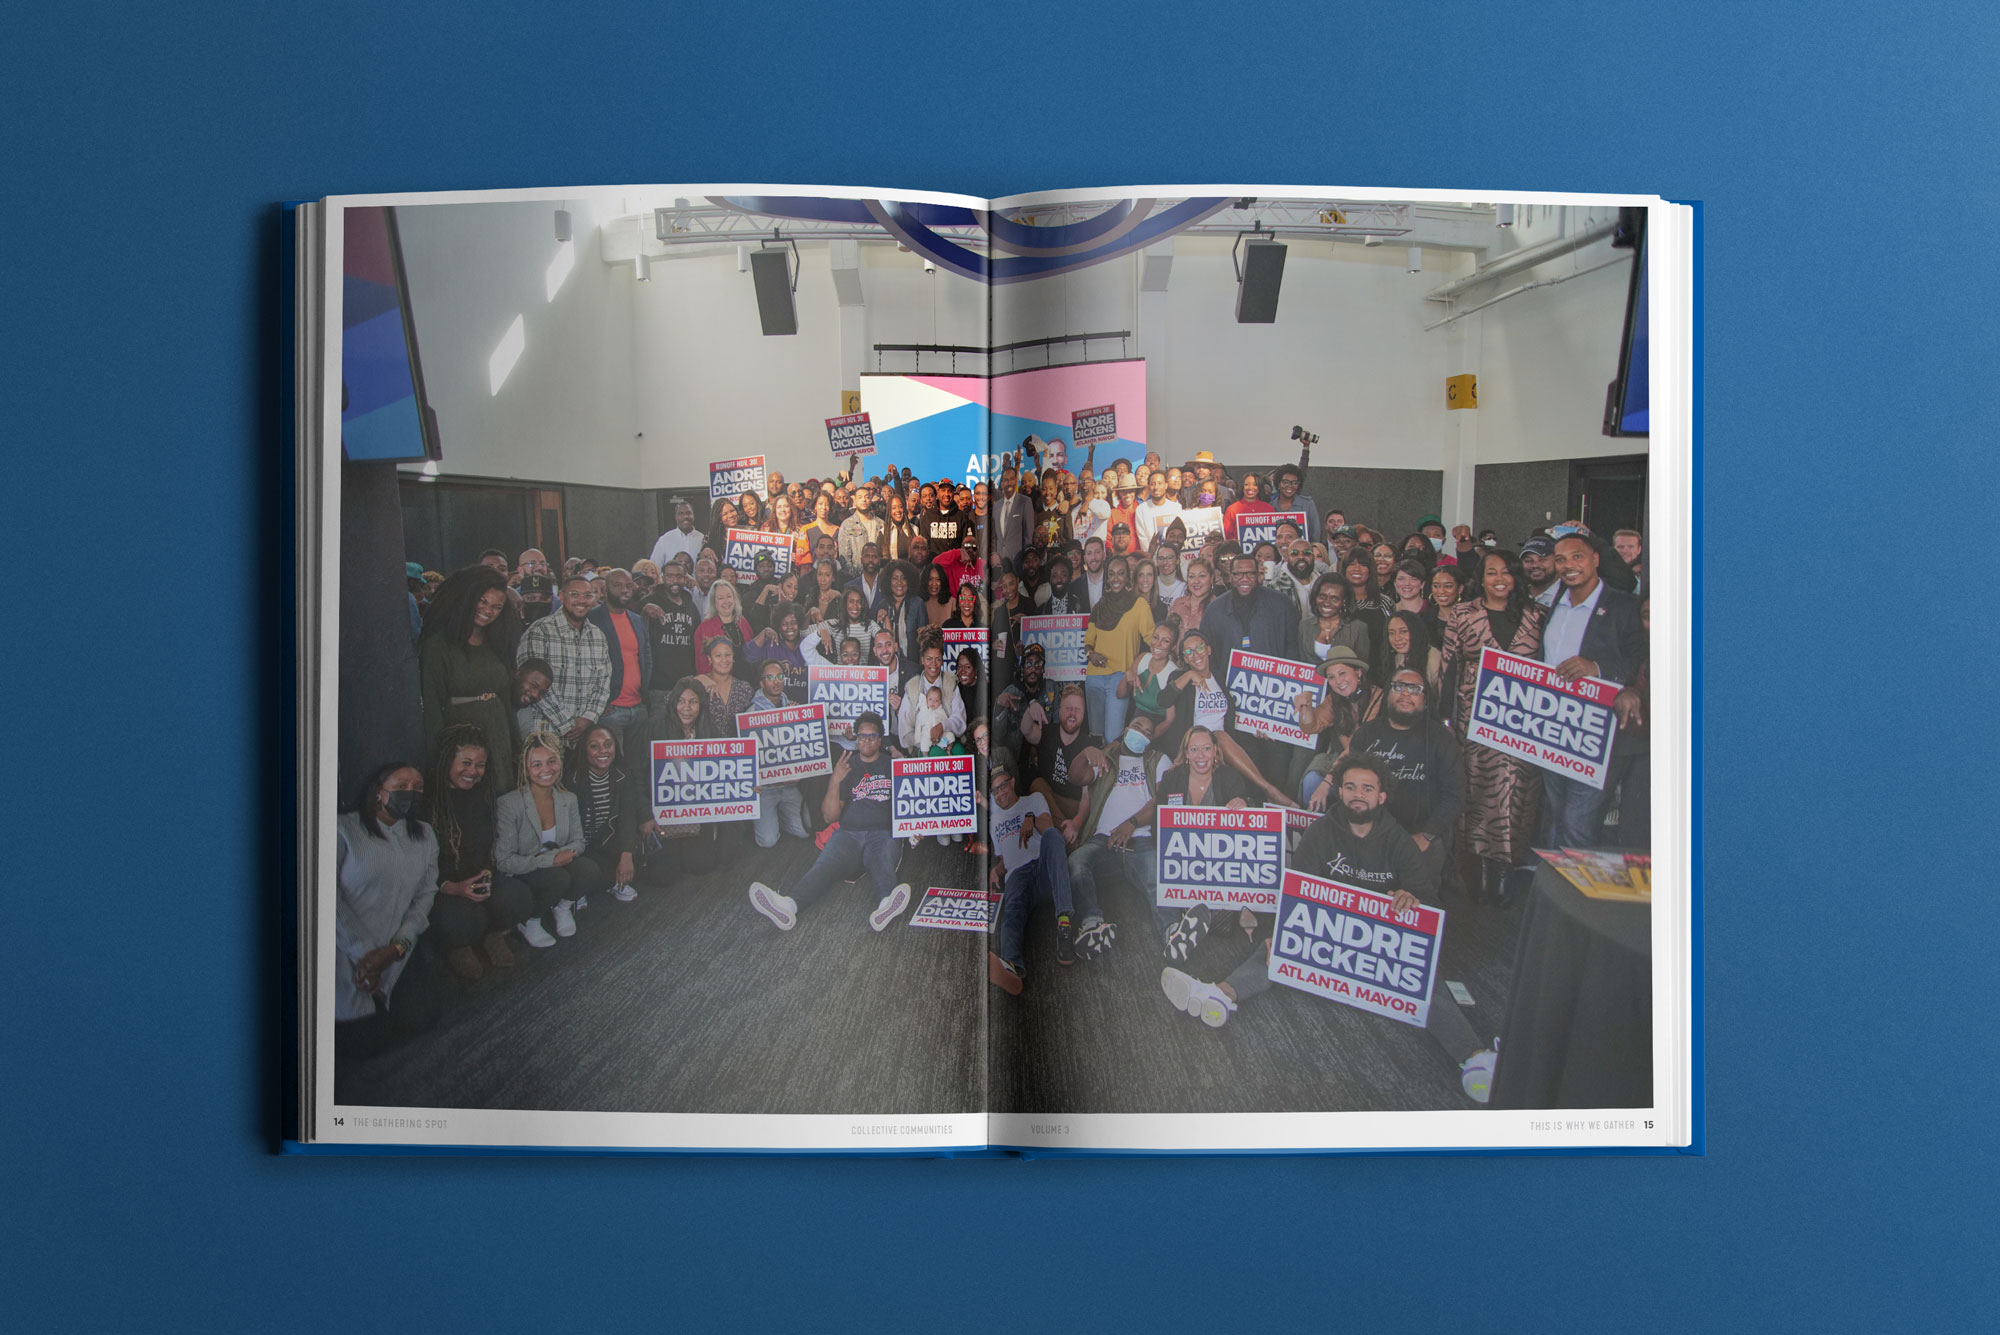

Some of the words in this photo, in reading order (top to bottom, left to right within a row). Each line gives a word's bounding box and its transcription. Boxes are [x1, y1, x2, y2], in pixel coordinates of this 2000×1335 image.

[1074, 414, 1114, 430] ANDRE
[831, 423, 871, 441] ANDRE
[1074, 424, 1114, 439] DICKENS
[832, 435, 873, 450] DICKENS
[713, 466, 763, 486] ANDRE
[712, 480, 764, 496] DICKENS
[1246, 516, 1270, 524] RUNOFF
[736, 532, 760, 542] RUNOFF
[1030, 619, 1054, 629] RUNOFF
[1056, 618, 1070, 628] NOV.
[1072, 618, 1082, 627] 30!
[962, 632, 976, 640] NOV.
[978, 632, 988, 640] 30!
[819, 668, 848, 678] RUNOFF
[850, 670, 866, 680] NOV.
[867, 670, 879, 680] 30!
[1241, 656, 1276, 672] RUNOFF
[1276, 664, 1296, 678] NOV.
[1298, 668, 1314, 680] 30!
[1496, 657, 1544, 682] RUNOFF
[1578, 681, 1600, 700] 30!
[814, 683, 884, 701] ANDRE
[1482, 676, 1608, 736] ANDRE
[748, 715, 780, 726] RUNOFF
[782, 711, 800, 722] NOV.
[802, 708, 814, 719] 30!
[748, 722, 824, 748] ANDRE
[1272, 724, 1310, 742] MAYOR
[1478, 698, 1602, 758] DICKENS
[665, 744, 704, 756] RUNOFF
[706, 743, 728, 755] NOV.
[730, 742, 745, 754] 30!
[760, 741, 825, 766] ICKENS
[1476, 726, 1538, 756] ATLANTA
[1542, 750, 1596, 778] MAYOR
[658, 758, 754, 784] ANDRE
[794, 762, 826, 774] MAYOR
[902, 762, 932, 774] RUNOFF
[934, 761, 950, 772] NOV.
[952, 760, 964, 770] 30!
[658, 781, 754, 803] DICKENS
[898, 774, 971, 798] ANDRE
[659, 807, 712, 819] ATLANTA
[714, 804, 754, 816] MAYOR
[897, 796, 972, 816] DICKENS
[898, 820, 939, 832] ATLANTA
[941, 818, 972, 828] MAYOR
[1173, 812, 1216, 826] RUNOFF
[1220, 814, 1245, 828] NOV.
[1248, 815, 1268, 828] 30!
[1164, 832, 1278, 862] ANDRE
[1164, 858, 1278, 885] DICKENS
[937, 890, 969, 898] RUNOFF
[1164, 888, 1224, 902] ATLANTA
[1228, 892, 1276, 905] MAYOR
[1300, 880, 1356, 908] RUNOFF
[1358, 896, 1390, 920] NOV.
[1394, 909, 1420, 928] 30!
[917, 917, 962, 926] ATLANTA
[1284, 902, 1429, 968] ANDRE
[1280, 930, 1424, 992] DICKENS
[1277, 963, 1350, 996] ATLANTA
[1355, 986, 1418, 1016] MAYOR
[334, 1118, 344, 1126] 14
[353, 1118, 369, 1126] THE
[372, 1118, 422, 1128] GATHERING
[425, 1120, 448, 1128] SPOT
[852, 1126, 898, 1135] COLLECTIVE
[900, 1125, 953, 1134] COMMUNITIES
[1031, 1125, 1062, 1134] VOLUME
[1064, 1126, 1070, 1134] 3
[1530, 1122, 1550, 1130] THIS
[1554, 1122, 1562, 1130] IS
[1566, 1121, 1584, 1130] WHY
[1588, 1121, 1600, 1130] WE
[1604, 1120, 1635, 1129] GATHER
[1644, 1120, 1654, 1128] 15
